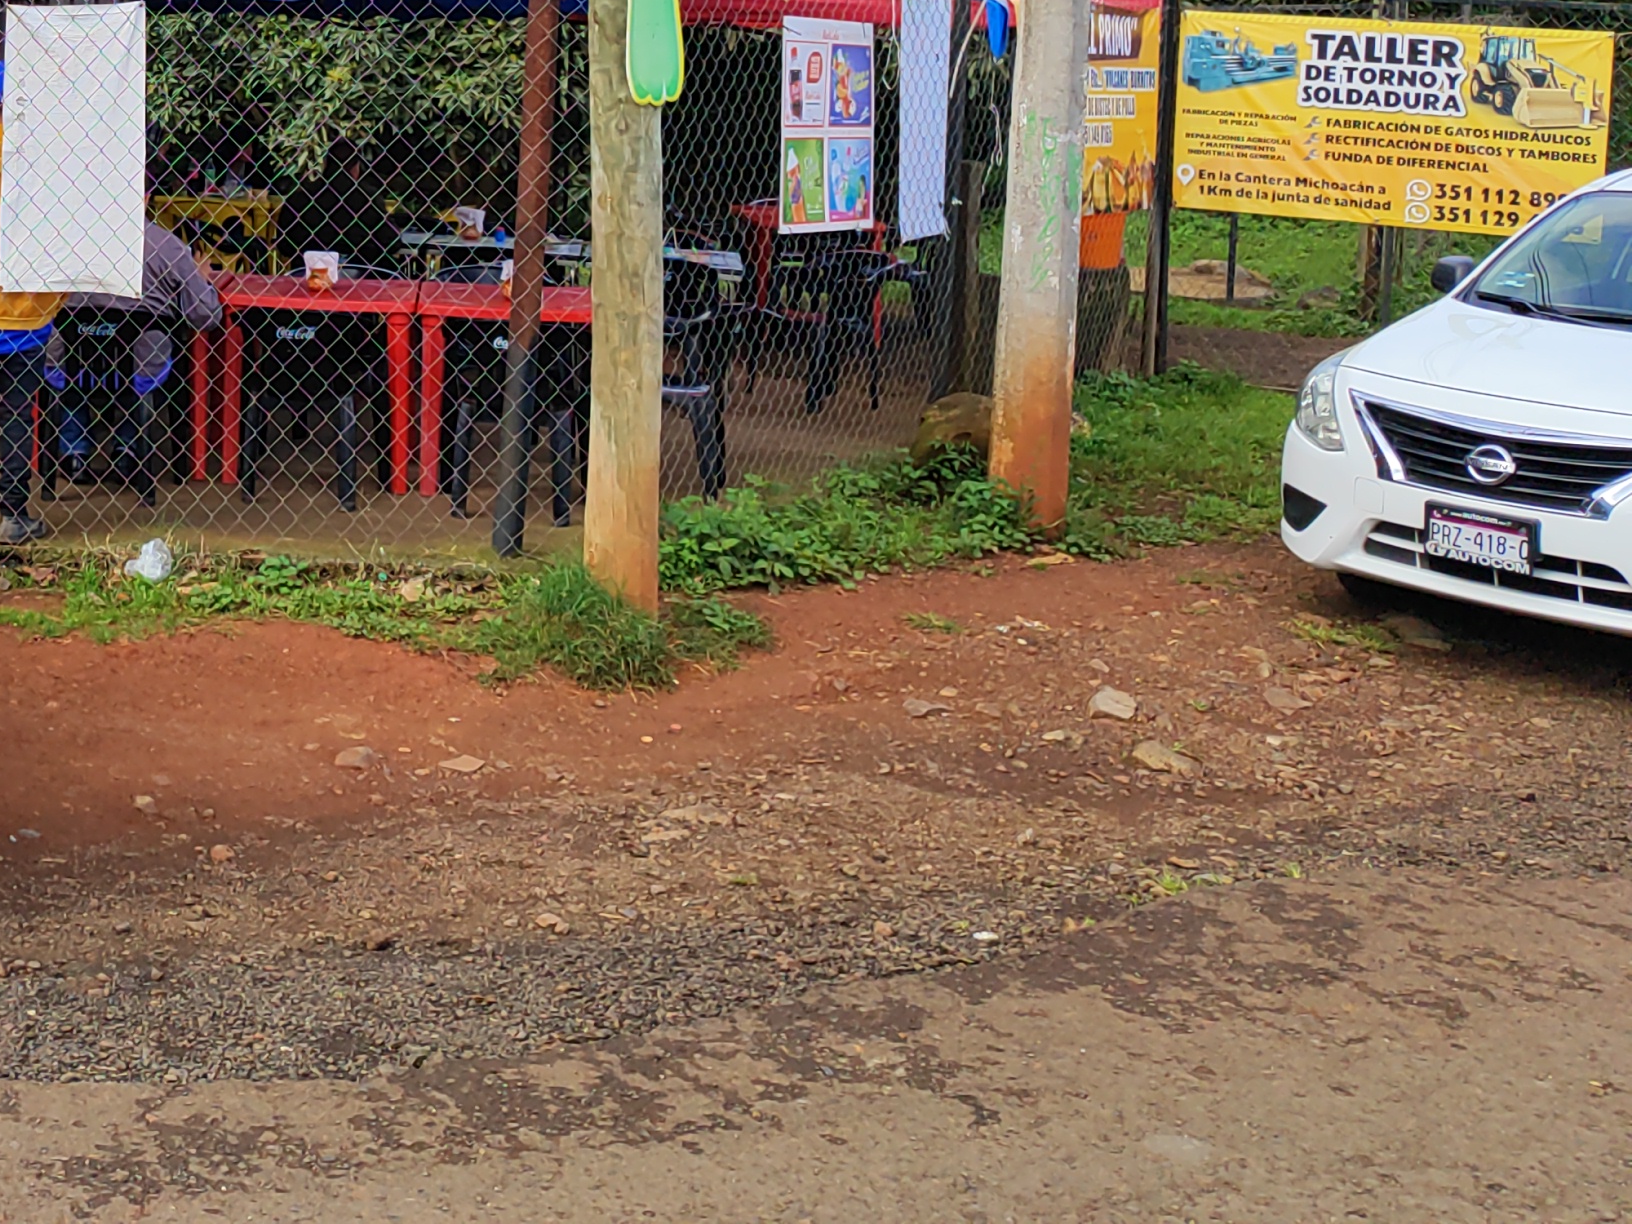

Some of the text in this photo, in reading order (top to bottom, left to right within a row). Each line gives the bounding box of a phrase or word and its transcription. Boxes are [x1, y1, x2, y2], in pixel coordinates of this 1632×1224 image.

[1311, 33, 1459, 69] TALLER
[1305, 64, 1462, 90] DE TORNO Y
[1301, 85, 1461, 113] SOLDADURA
[1230, 119, 1258, 127] PIEZAS
[1326, 117, 1591, 147] FABRICACIÓN DE GATOS HIDRÁULICOS
[1185, 132, 1245, 142] REPARACIONES
[1206, 142, 1276, 152] MANTENIMIENTO
[1325, 134, 1597, 164] RECTIFICACIÓN DE DISCOS Y TAMBORES
[1187, 148, 1286, 162] INDUSTRIAL EN GENERAL
[1324, 151, 1489, 173] FUNDA DE DIFERENCIAL
[1198, 169, 1386, 195] En la Cantera Michoacán a
[1236, 187, 1252, 199] de
[1256, 188, 1268, 200] la
[1271, 190, 1310, 204] junta
[1313, 193, 1331, 206] de
[1334, 196, 1391, 211] sanidad
[1435, 183, 1472, 201] 351
[1482, 187, 1520, 206] 112
[1433, 205, 1471, 223] 351
[1480, 209, 1520, 227] 129
[1448, 548, 1530, 575] AUTOCOM
